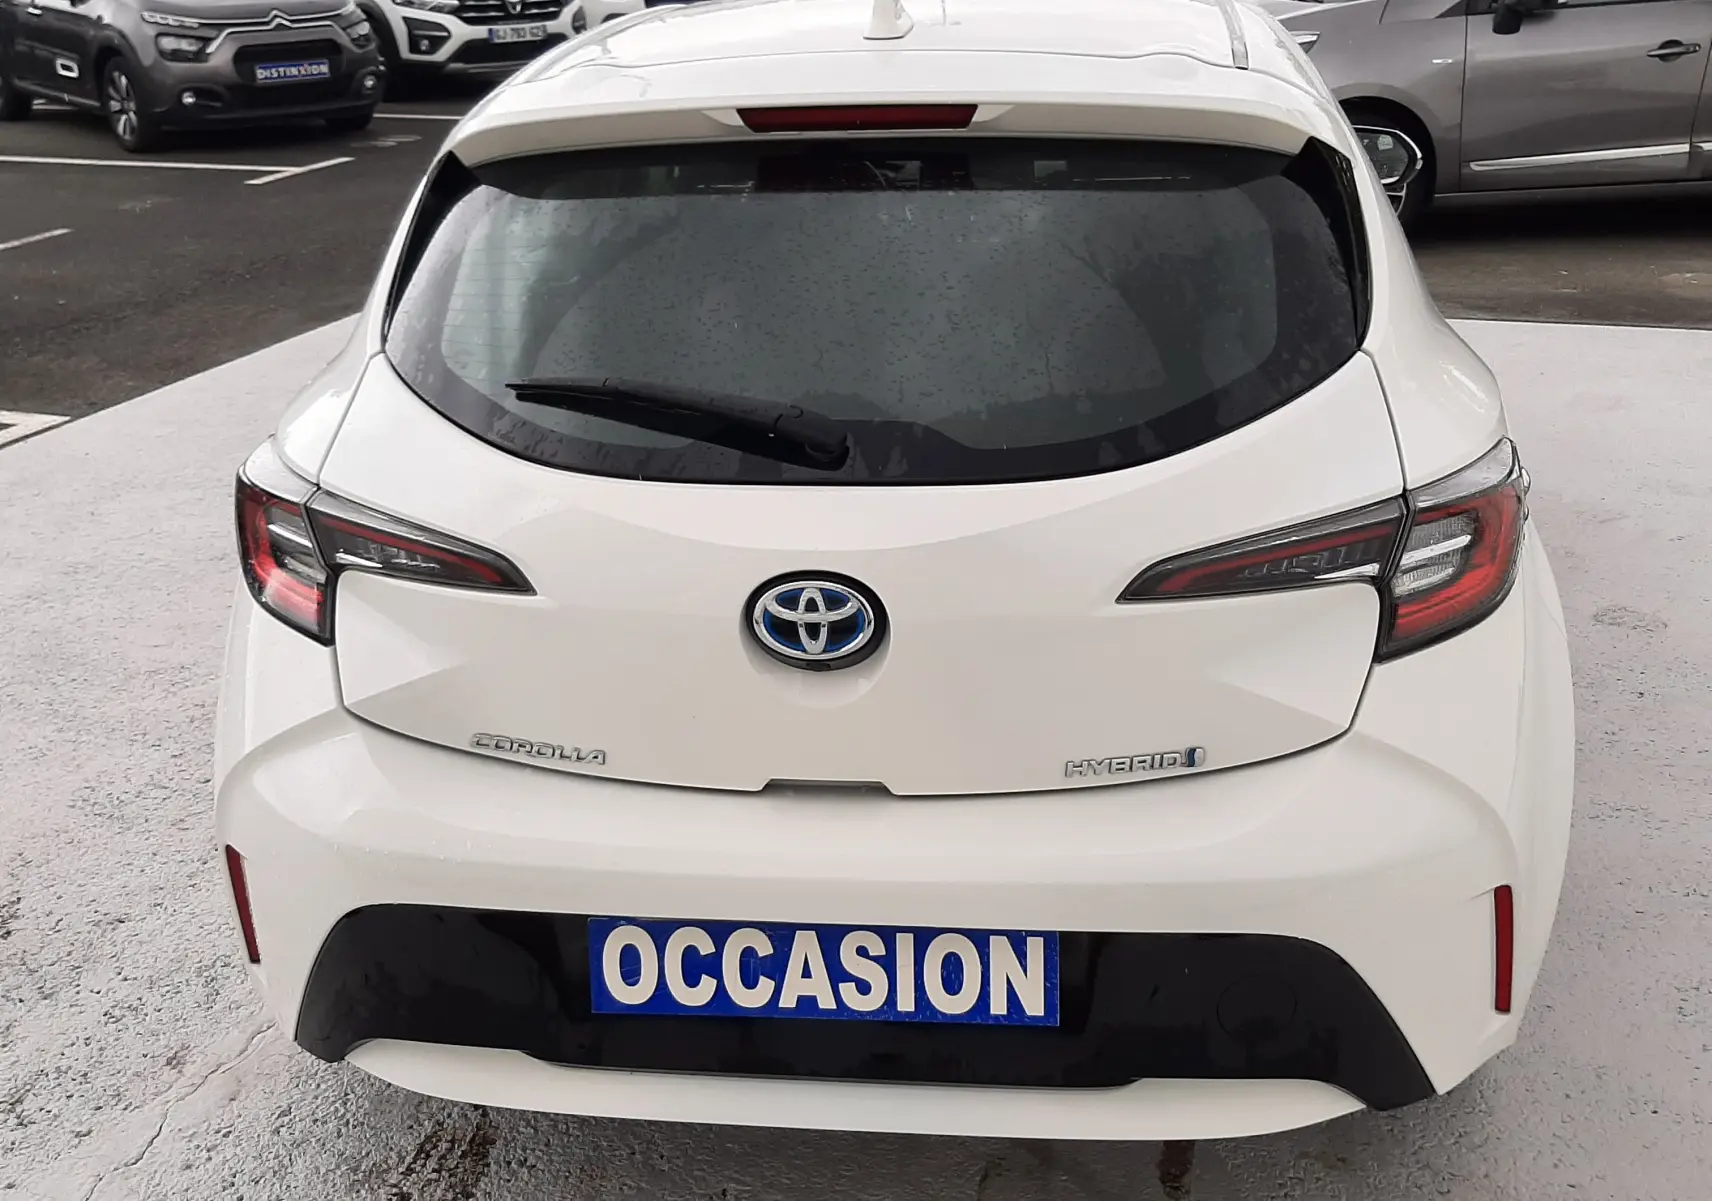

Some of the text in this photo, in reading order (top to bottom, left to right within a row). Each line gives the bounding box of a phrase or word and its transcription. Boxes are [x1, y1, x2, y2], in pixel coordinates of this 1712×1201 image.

[256, 64, 329, 80] DISTINXION
[471, 732, 607, 766] COROLLA
[1065, 752, 1182, 778] HYBRID
[602, 925, 1045, 1016] OCCASION
